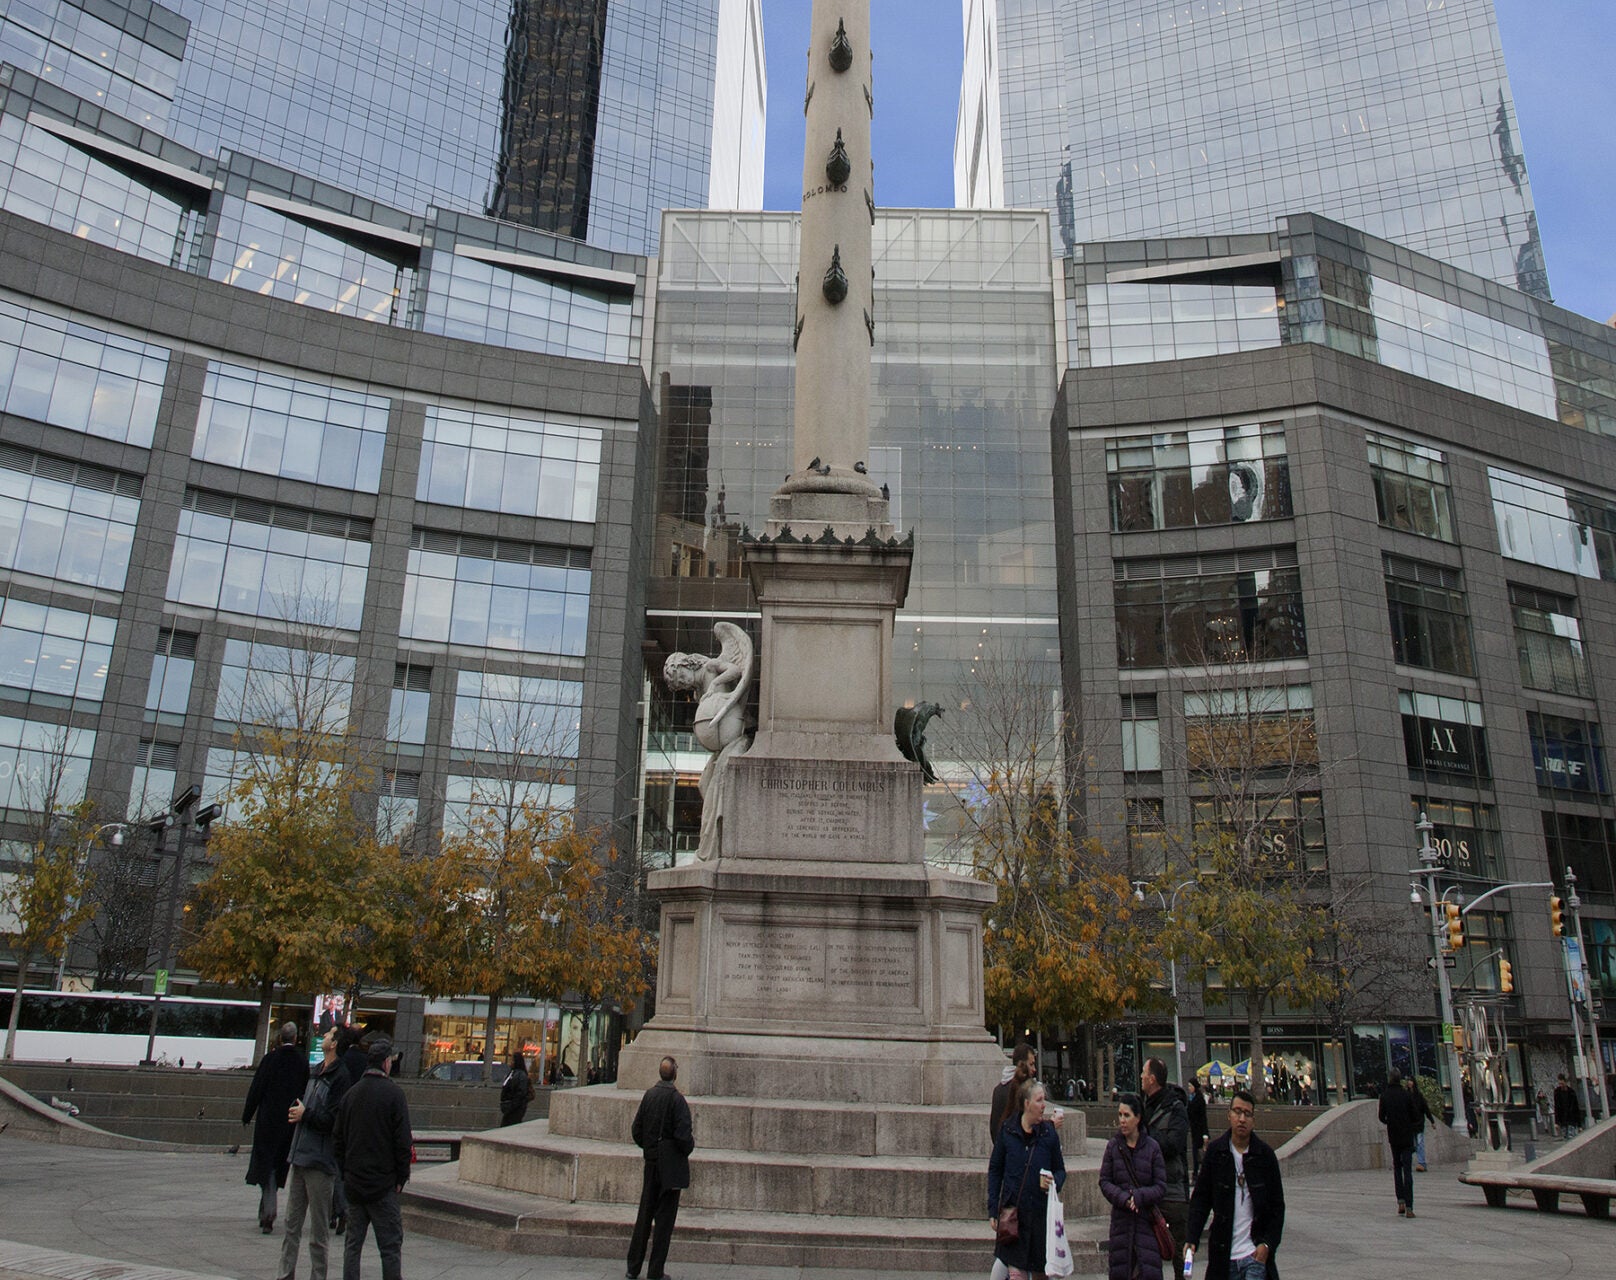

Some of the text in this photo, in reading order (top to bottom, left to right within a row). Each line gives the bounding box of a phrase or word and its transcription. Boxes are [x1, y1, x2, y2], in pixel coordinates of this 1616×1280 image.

[761, 779, 885, 793] CHRISTOPHER COLUMBUS
[1266, 1026, 1284, 1034] BOSS
